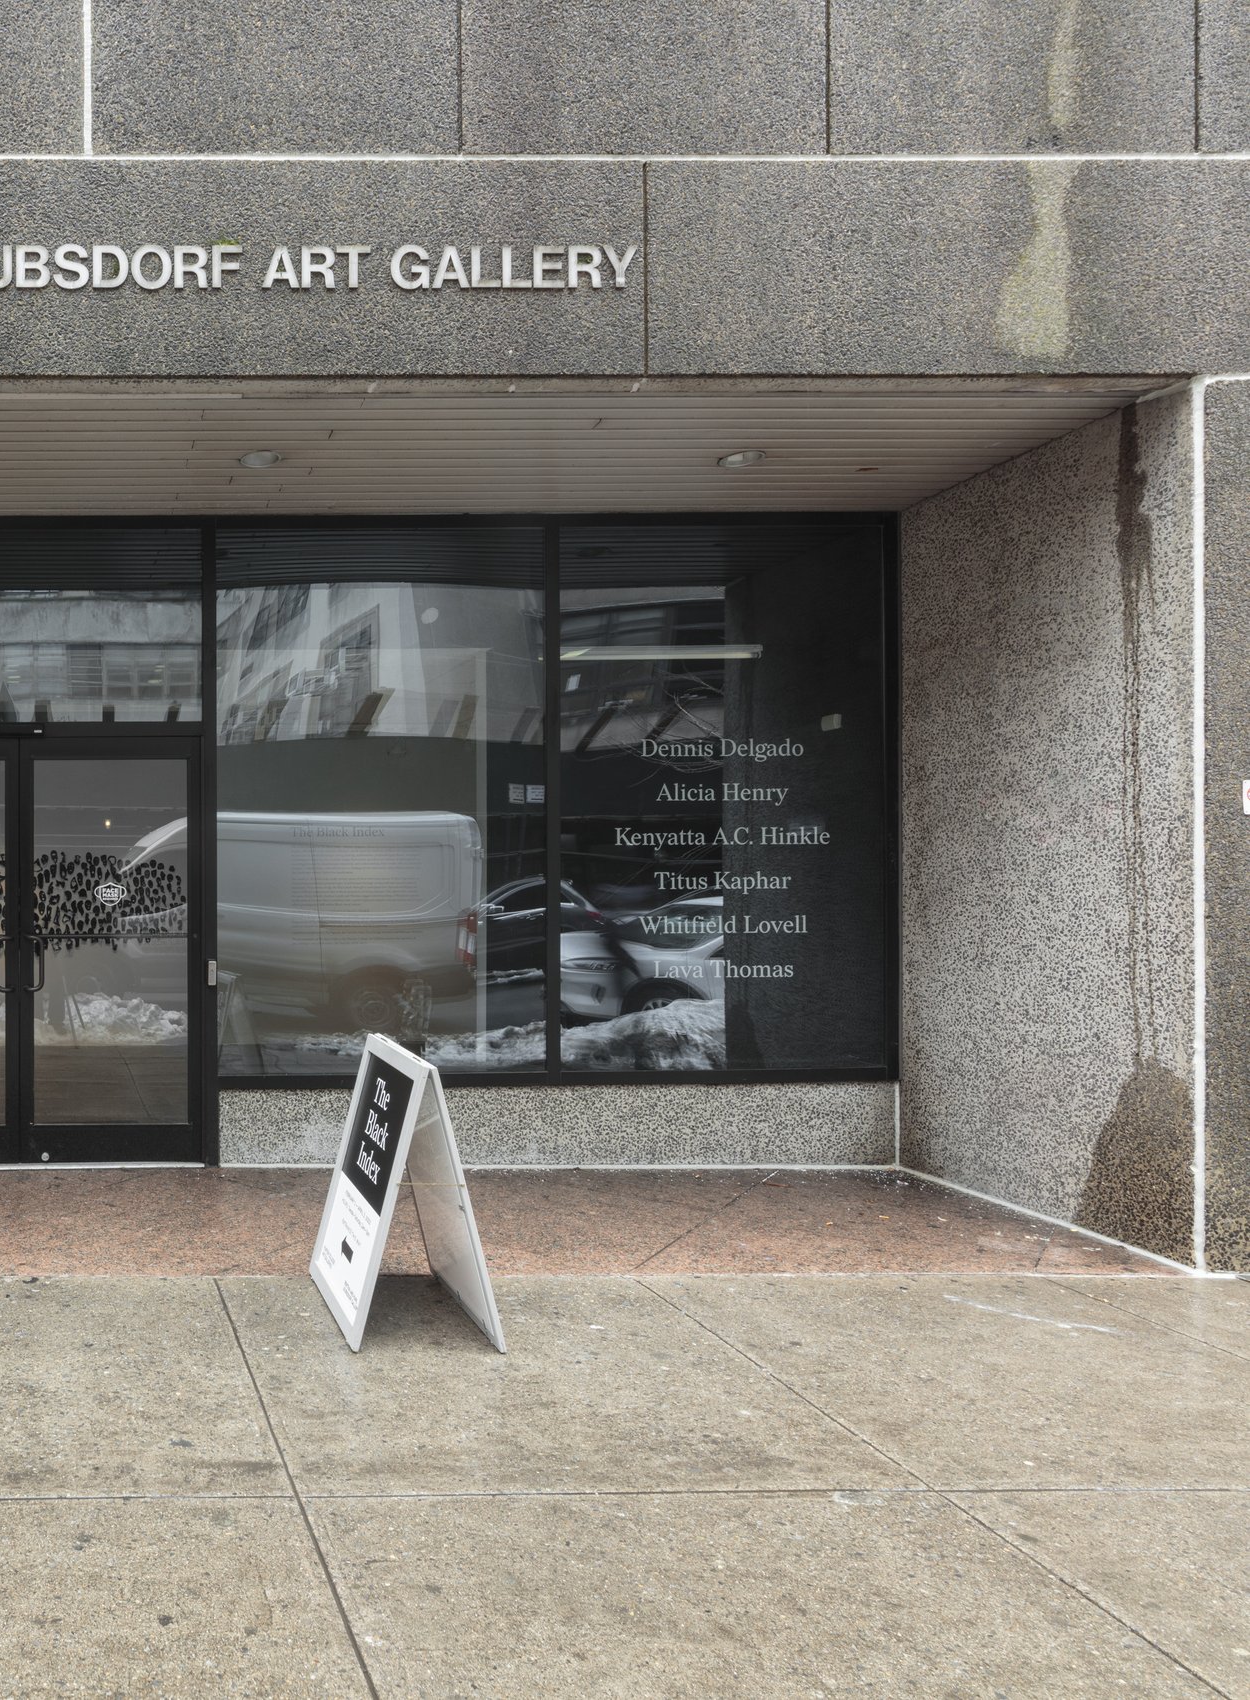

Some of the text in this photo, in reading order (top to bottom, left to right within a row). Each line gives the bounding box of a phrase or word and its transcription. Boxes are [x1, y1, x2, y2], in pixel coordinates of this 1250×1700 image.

[261, 243, 371, 289] ART
[389, 243, 638, 290] GALLERY
[640, 738, 804, 761] Dennis Delgado
[656, 783, 788, 806] Alicia Henry
[291, 826, 385, 838] The Black Index
[614, 826, 831, 850] Kenyatta A.C. Hinkle
[653, 870, 792, 895] Titus Kaphar
[639, 914, 808, 934] Whitfield Lovell
[653, 959, 794, 979] Lava Thomas
[374, 1076, 391, 1111] The
[364, 1108, 390, 1151] Black
[356, 1140, 382, 1186] Index
